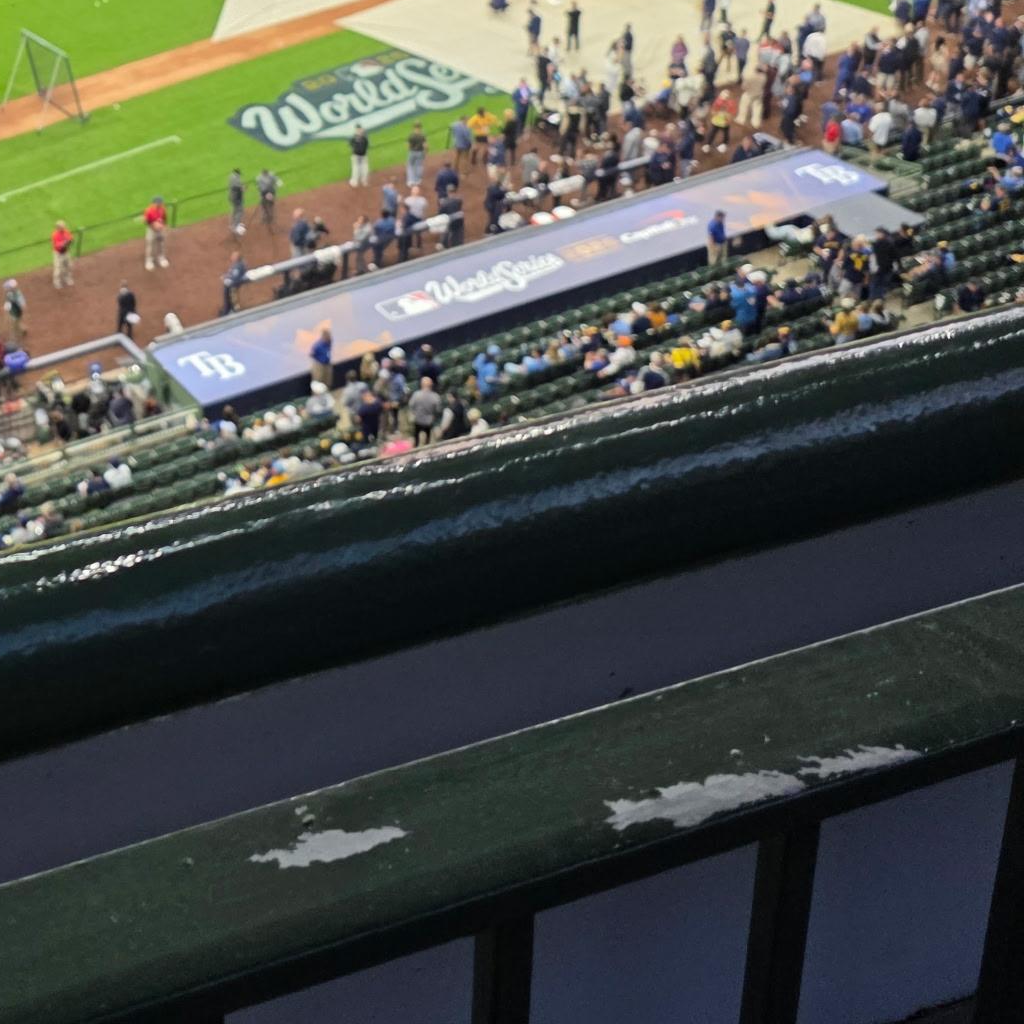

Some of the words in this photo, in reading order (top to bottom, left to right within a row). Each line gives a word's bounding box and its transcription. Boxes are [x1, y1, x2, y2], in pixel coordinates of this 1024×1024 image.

[241, 67, 418, 147] World
[793, 162, 860, 187] TB
[424, 262, 502, 305] World
[495, 252, 566, 293] Series
[177, 351, 246, 380] TB
